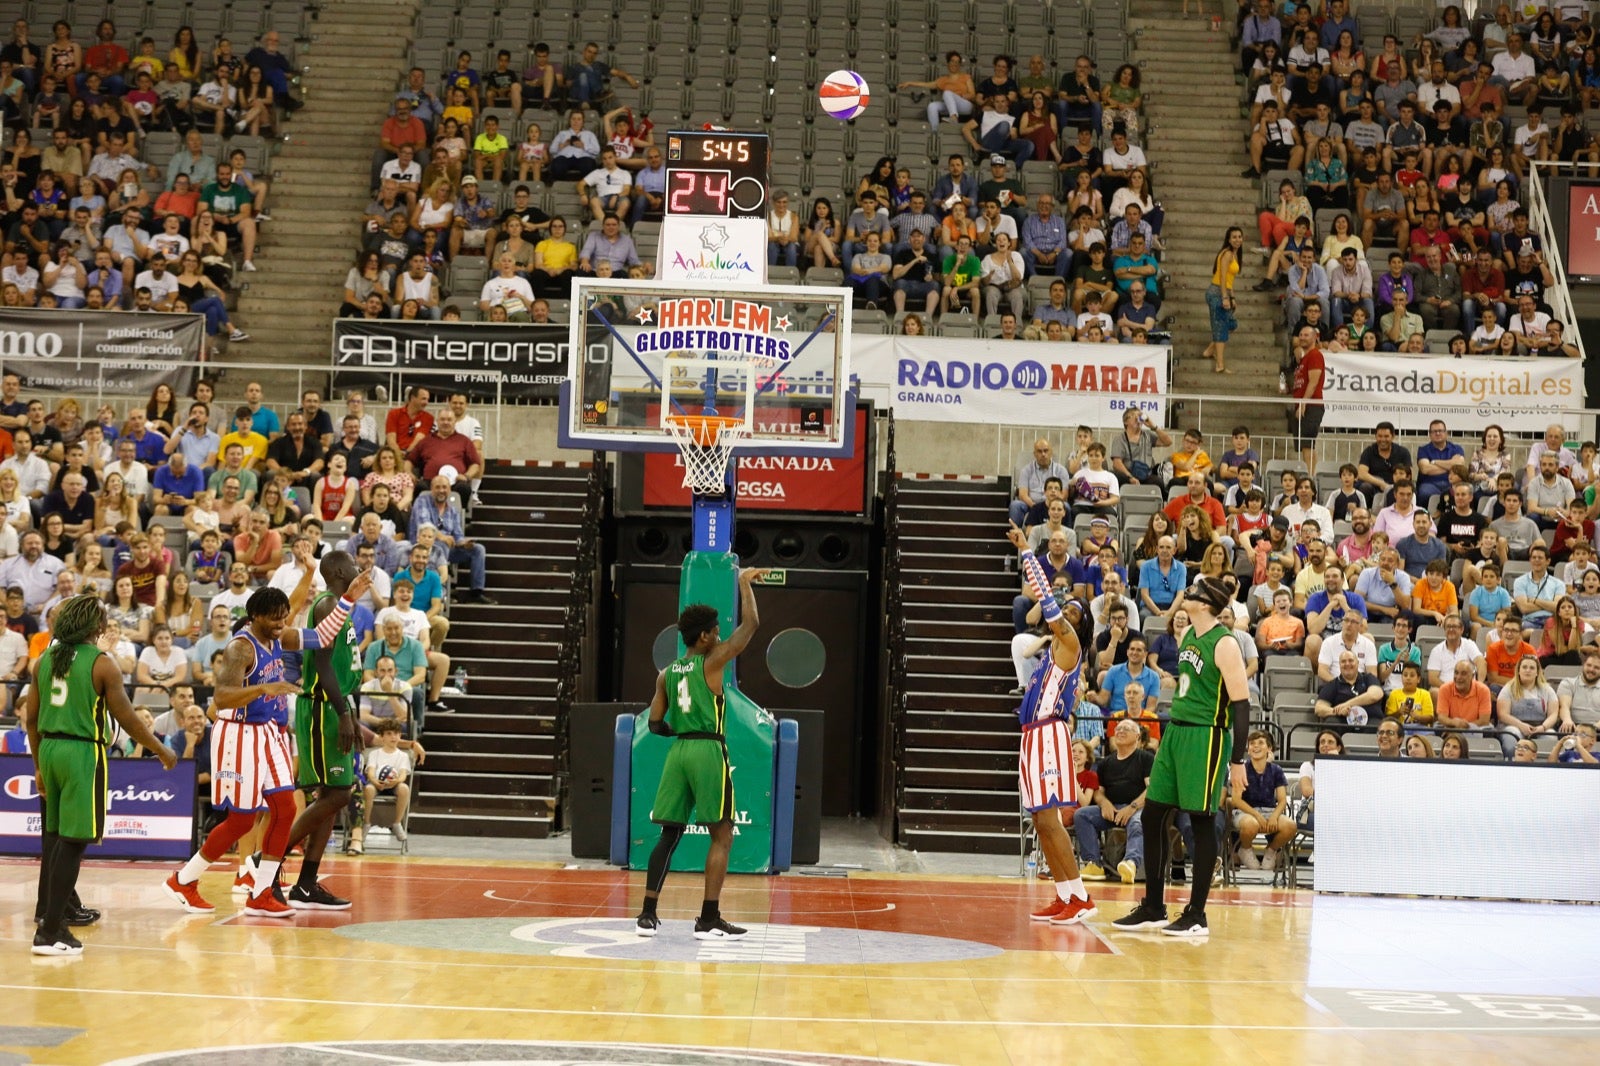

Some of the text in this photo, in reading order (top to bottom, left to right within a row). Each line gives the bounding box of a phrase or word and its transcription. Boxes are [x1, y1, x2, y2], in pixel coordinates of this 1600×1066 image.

[703, 140, 749, 162] 5:45
[671, 173, 727, 212] 24
[672, 251, 754, 273] Andalucía
[659, 299, 771, 333] HARLEM
[107, 328, 173, 340] publicidad
[637, 330, 790, 360] GLOBETROTTERS
[96, 342, 182, 355] comunicación
[455, 374, 470, 383] BY
[897, 358, 1158, 394] RADIO MARCA
[897, 391, 962, 405] GRANADA
[1140, 401, 1158, 411] FM
[738, 457, 835, 471] RANADA
[709, 511, 717, 547] MONDO
[1451, 525, 1475, 536] MARVEL
[51, 678, 68, 707] 5
